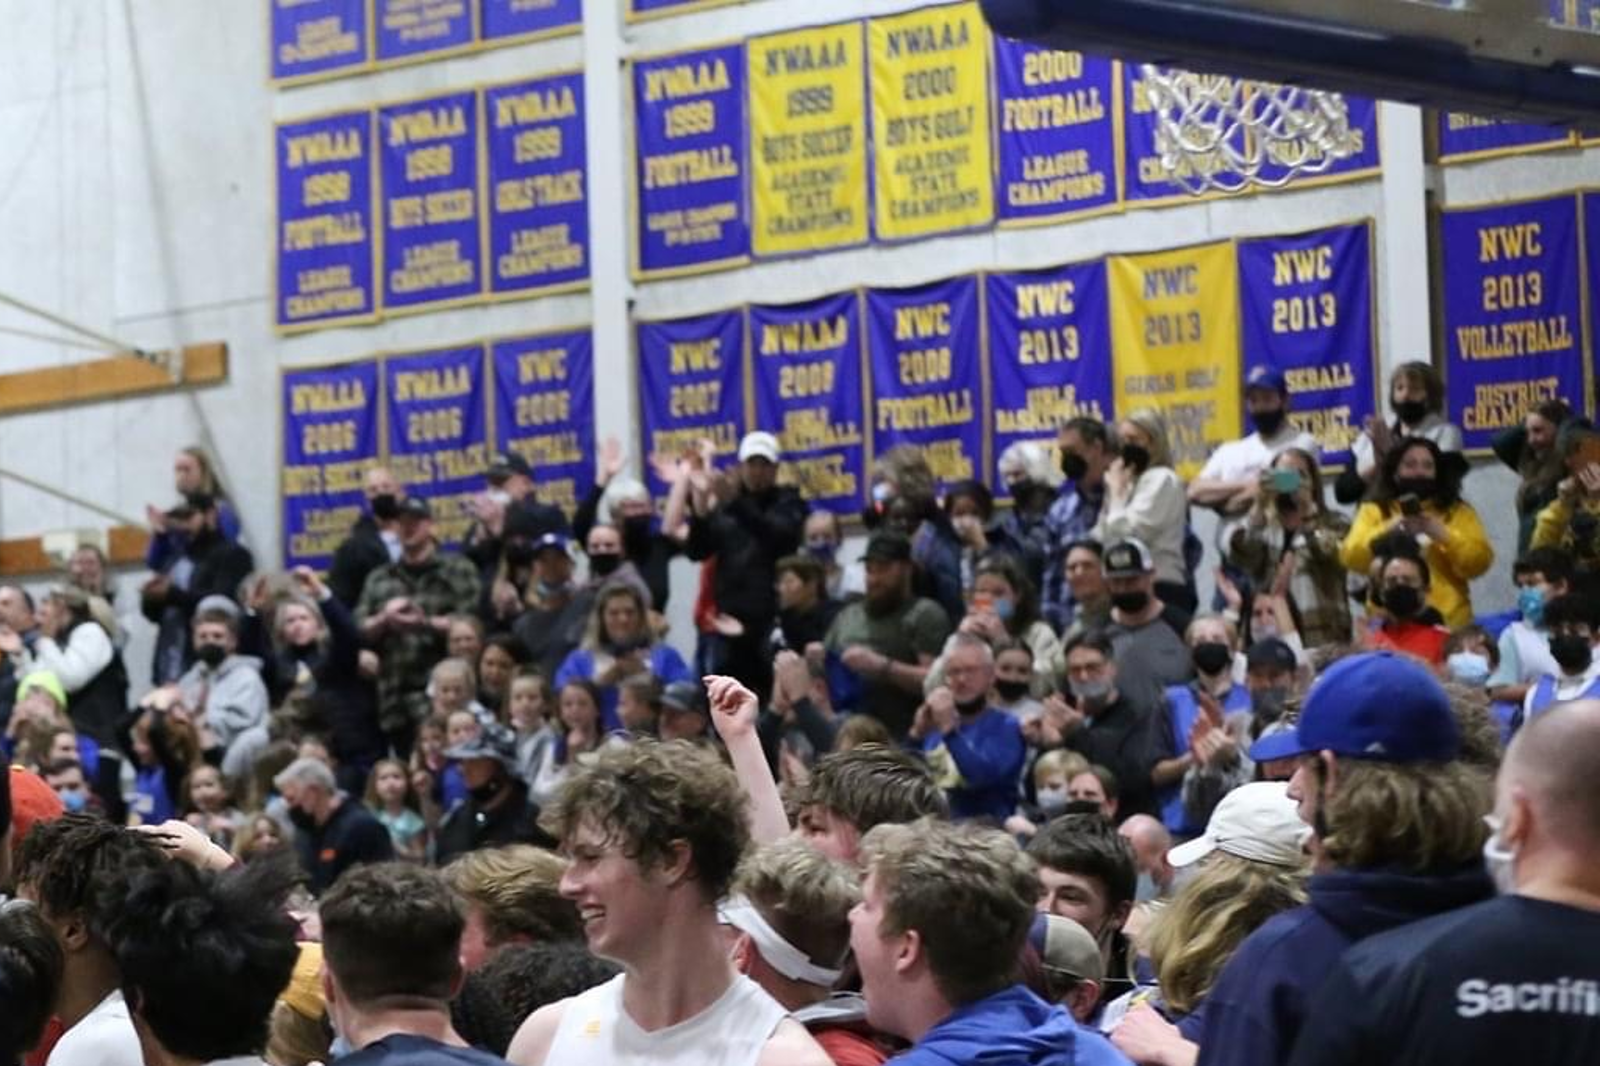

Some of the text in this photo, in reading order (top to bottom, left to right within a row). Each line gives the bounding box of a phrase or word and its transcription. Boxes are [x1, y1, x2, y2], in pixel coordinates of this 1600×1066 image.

[903, 66, 957, 100] 2000
[1023, 50, 1084, 86] 2000
[1003, 87, 1104, 132] FOOTBALL
[887, 114, 932, 147] BOYS
[1022, 149, 1089, 181] LEAGUE
[1008, 173, 1106, 207] CHAMPIONS
[1478, 222, 1542, 263] NWC
[1143, 264, 1200, 298] NWC
[1273, 245, 1334, 287] NWC
[1015, 279, 1076, 320] NWC
[1483, 271, 1542, 312] 2013
[894, 301, 951, 341] NWC
[1143, 310, 1203, 347] 2013
[1272, 293, 1337, 334] 2013
[669, 337, 722, 375] NWC
[1018, 324, 1081, 366] 2013
[1456, 315, 1573, 362] VOLLEYBALL
[1284, 362, 1355, 395] SEBALL
[1475, 377, 1559, 405] DISTRICT
[877, 388, 974, 432] FOOTBALL
[1288, 405, 1352, 436] STRICT
[1455, 976, 1600, 1018] Sacrifi
